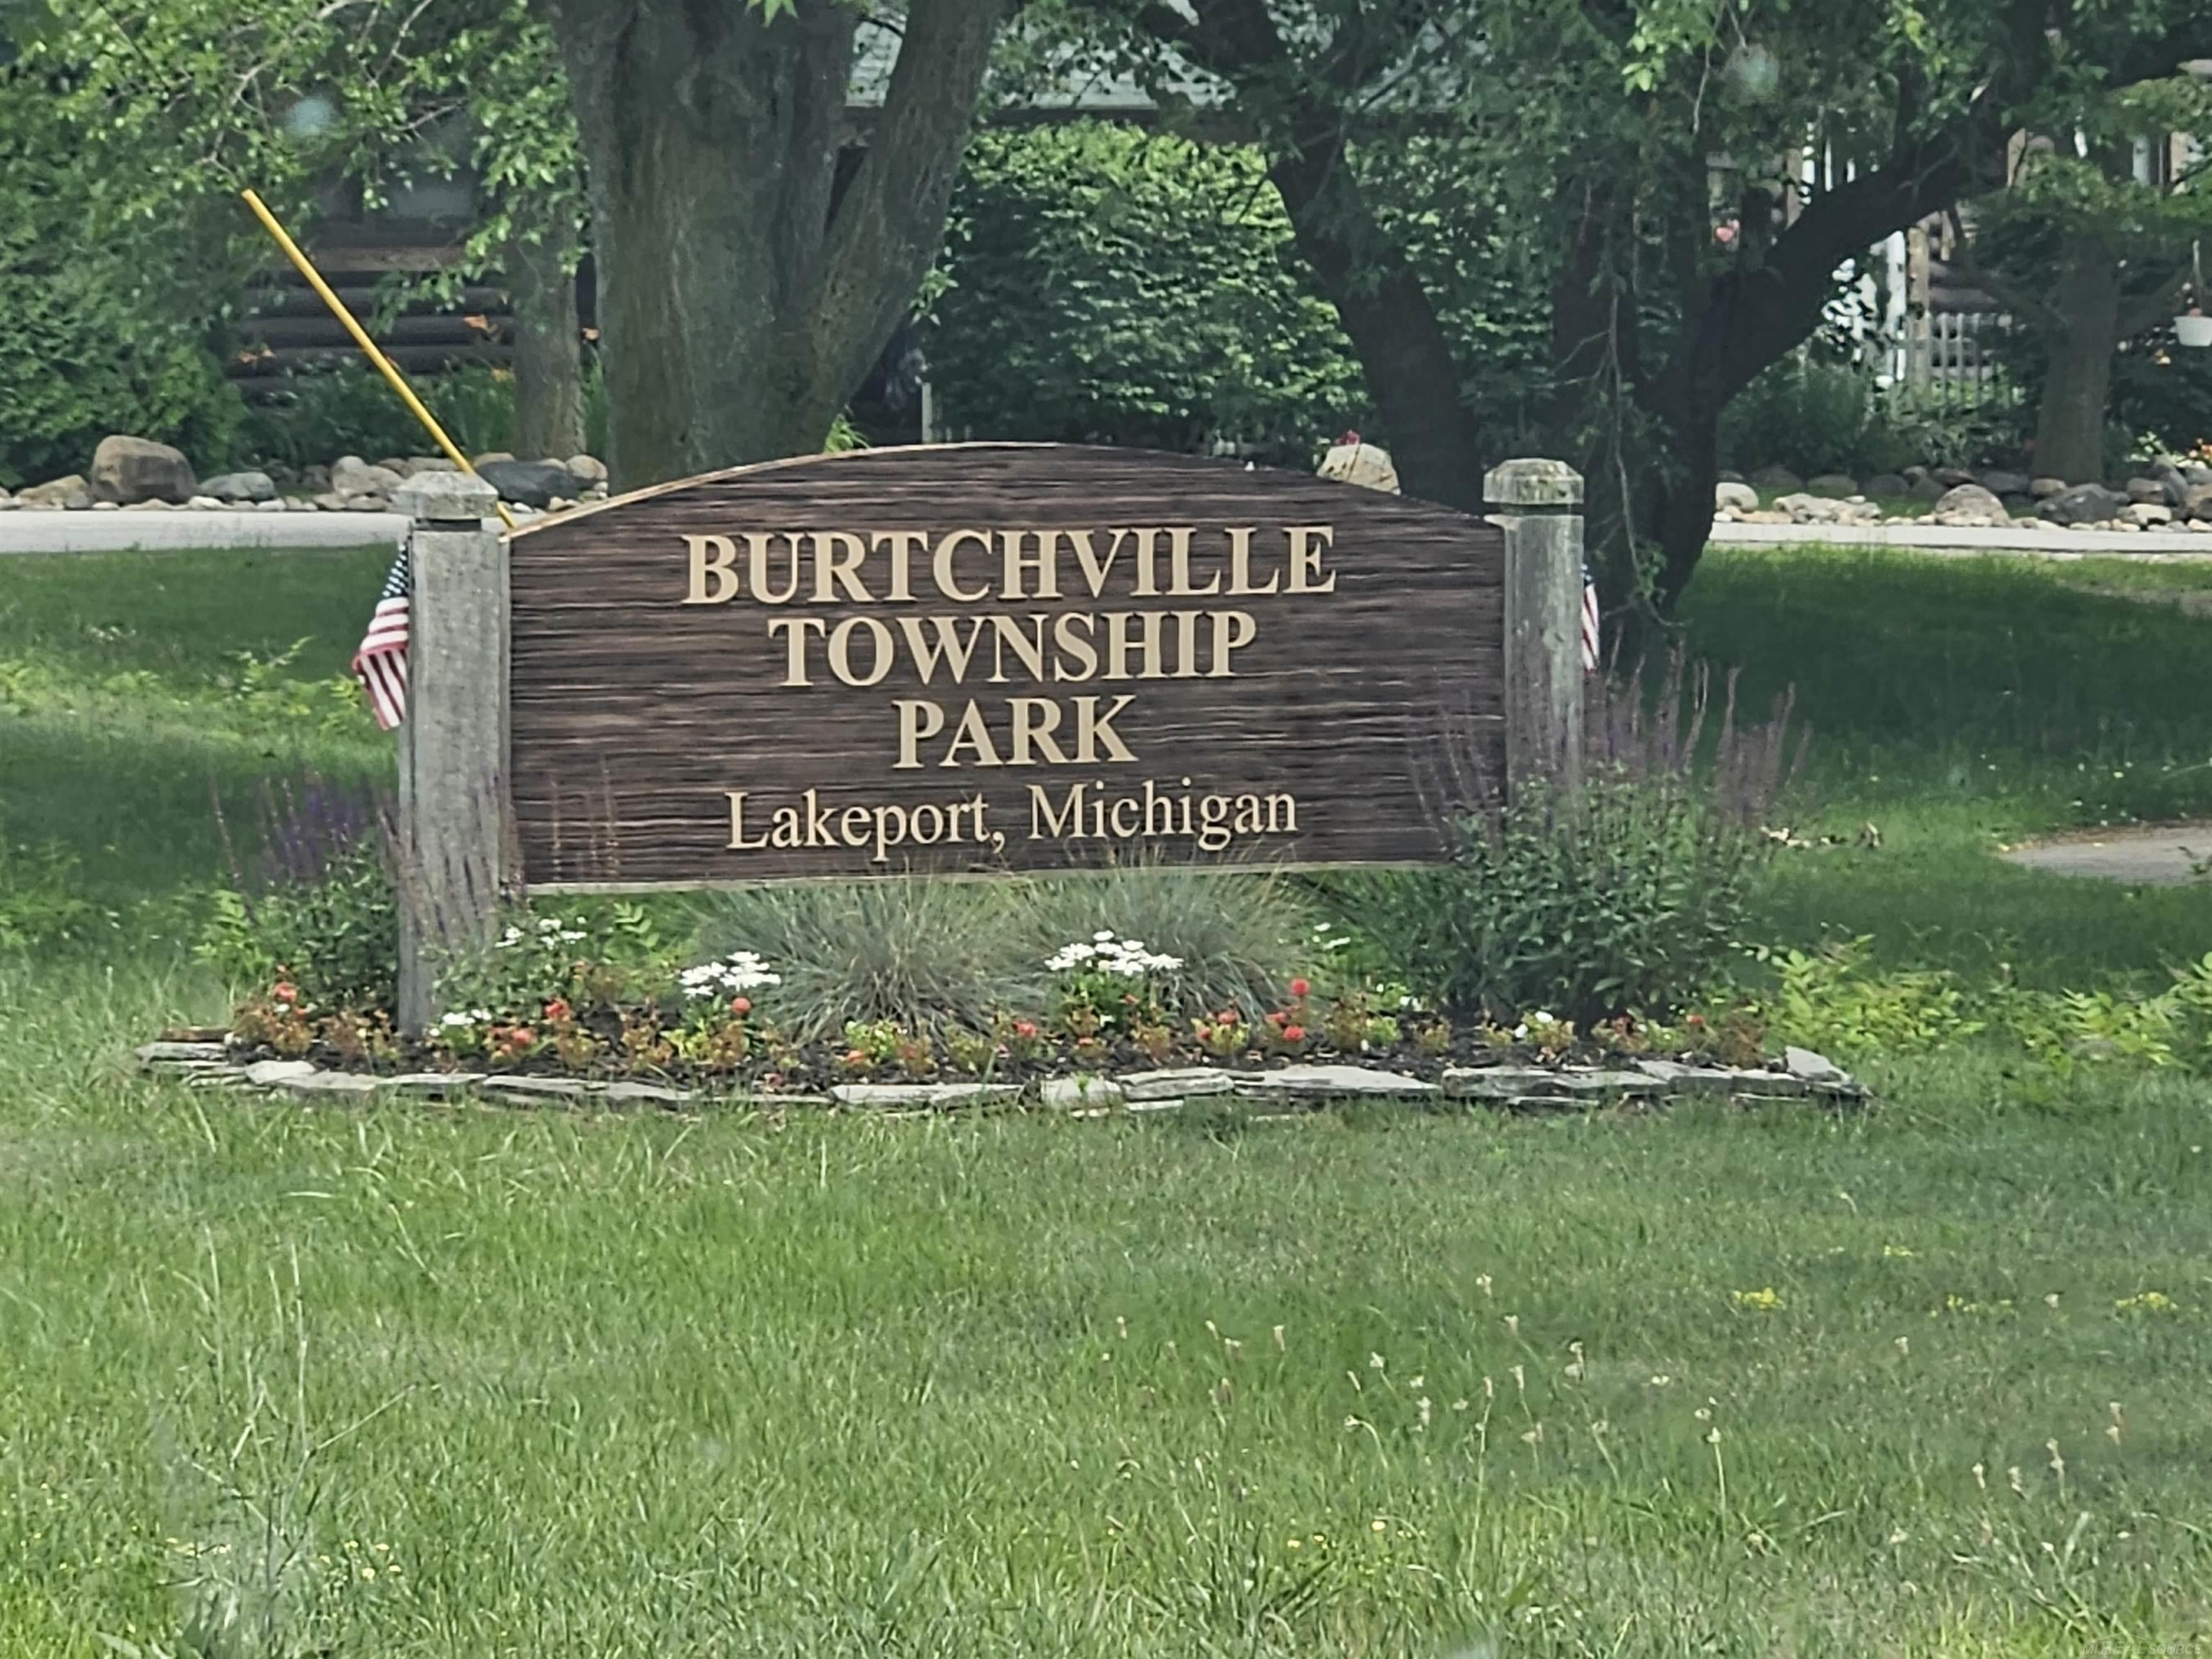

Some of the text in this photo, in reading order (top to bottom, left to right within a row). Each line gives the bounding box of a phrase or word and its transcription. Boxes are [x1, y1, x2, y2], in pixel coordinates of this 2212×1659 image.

[680, 526, 1336, 605] BURTCHVILLE
[768, 611, 1256, 686] TOWNSHIP
[891, 695, 1139, 768] PARK
[725, 777, 1298, 862] Lakeport, Michigan
